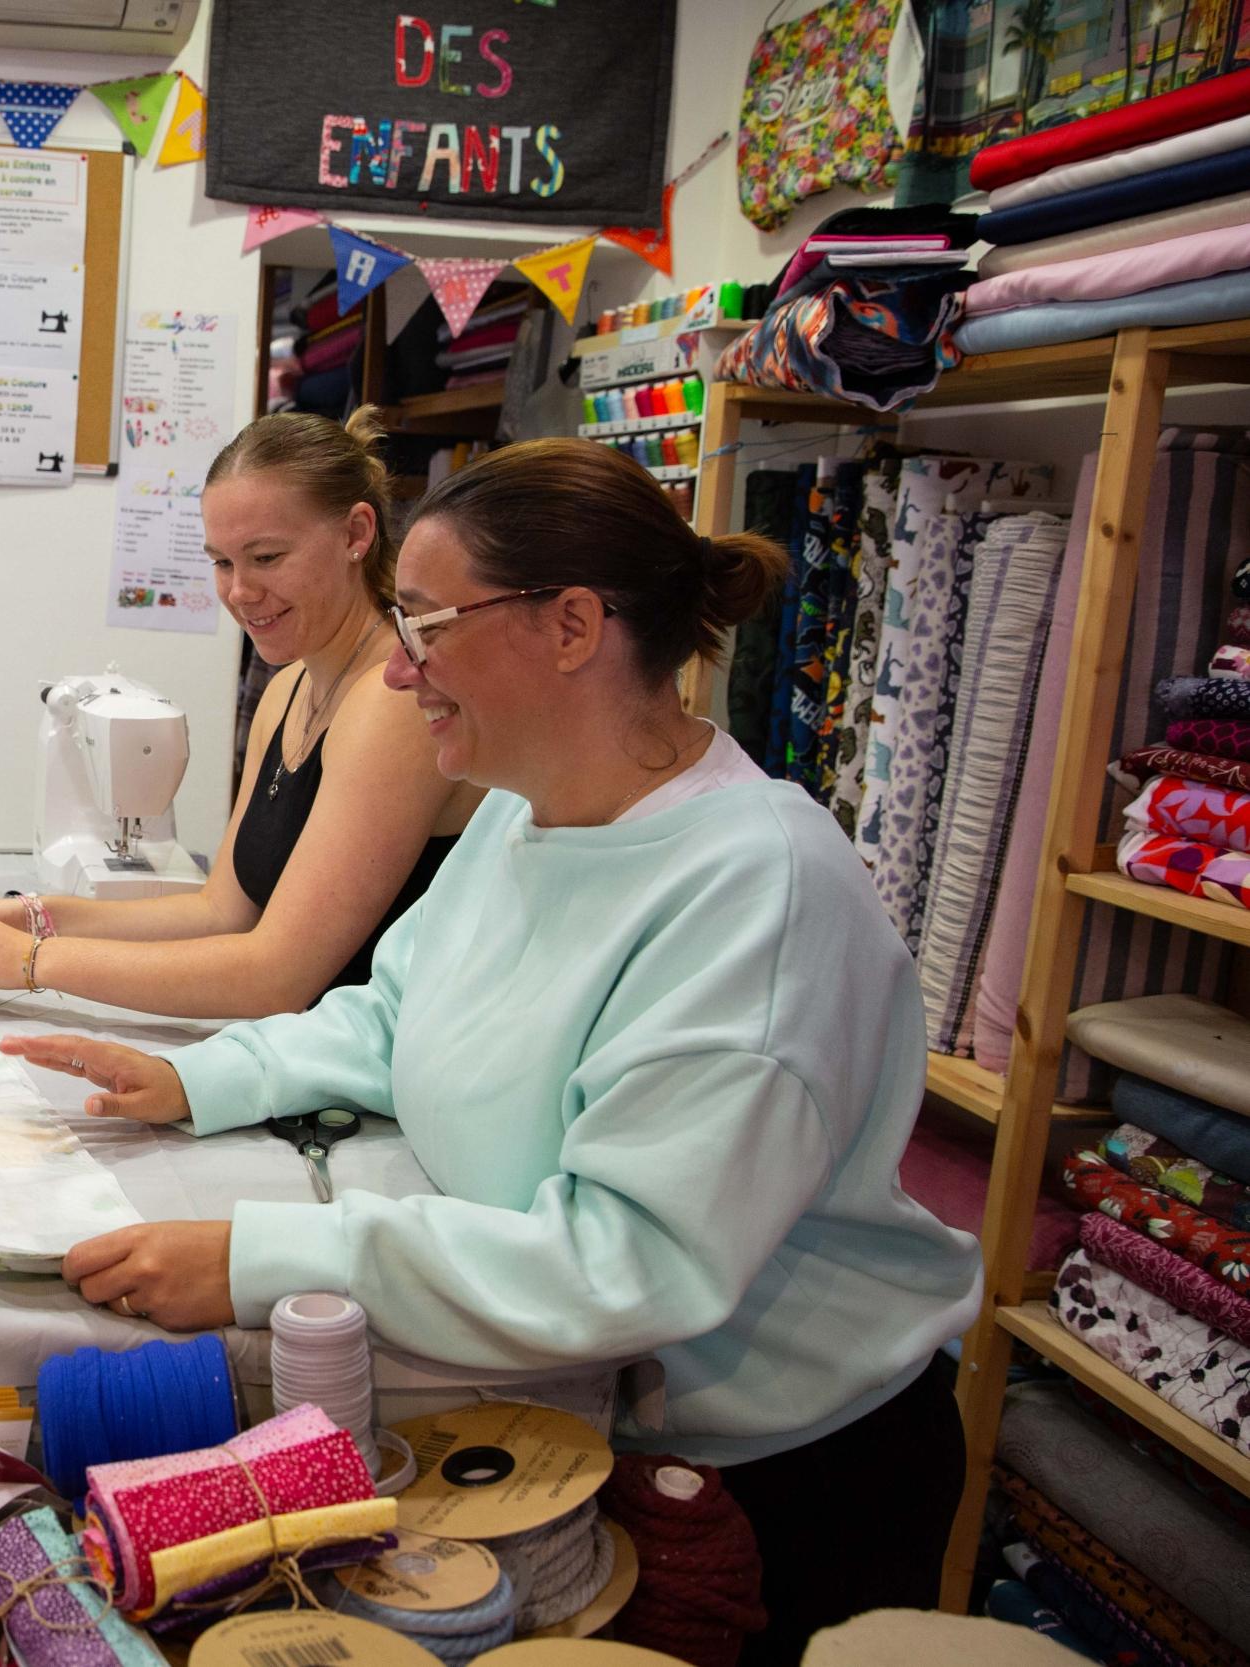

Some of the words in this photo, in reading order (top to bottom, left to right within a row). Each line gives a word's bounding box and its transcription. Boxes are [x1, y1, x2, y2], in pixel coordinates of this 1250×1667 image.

[395, 14, 514, 98] DES
[318, 113, 565, 197] ENFANTS
[12, 159, 51, 172] Enfants
[9, 174, 42, 186] coudre
[44, 177, 57, 186] en
[0, 187, 33, 198] service
[345, 249, 376, 287] A
[546, 263, 573, 293] T
[11, 273, 48, 284] Couture
[10, 379, 48, 389] Couture
